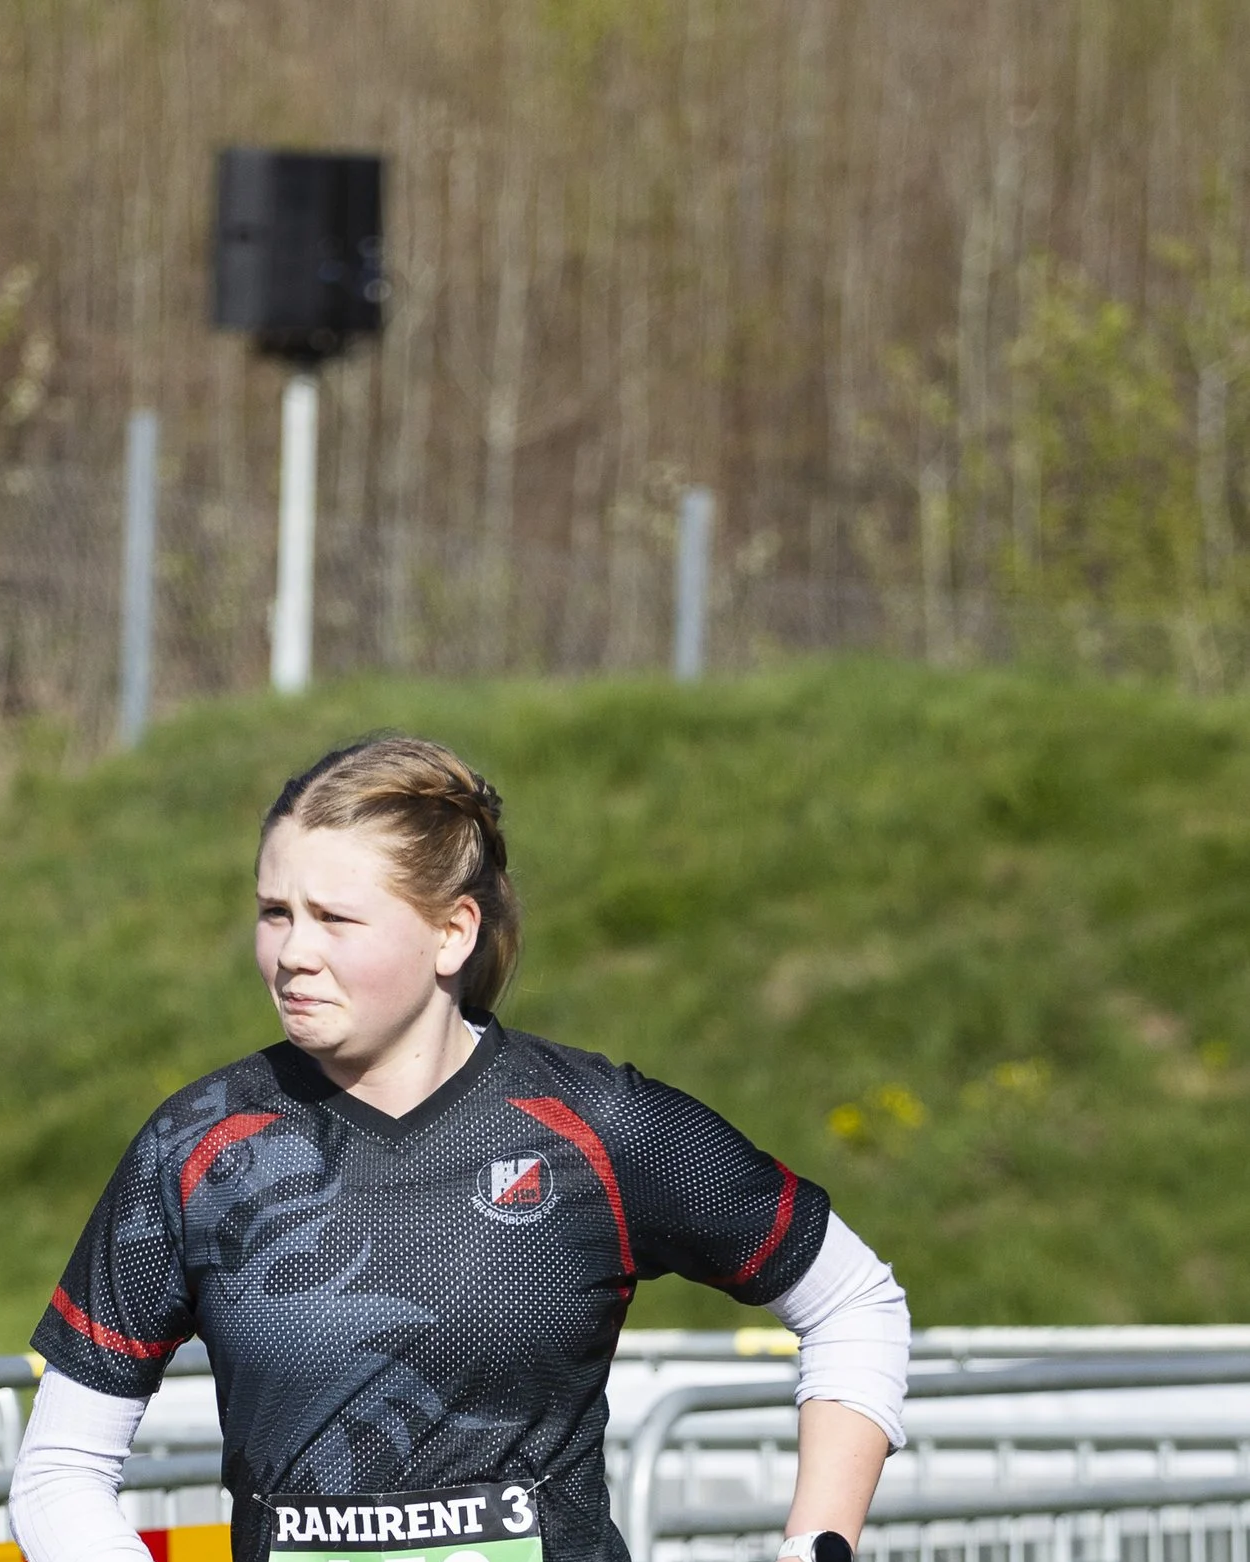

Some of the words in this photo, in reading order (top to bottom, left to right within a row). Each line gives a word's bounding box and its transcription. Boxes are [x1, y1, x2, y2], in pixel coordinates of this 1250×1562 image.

[470, 1194, 543, 1225] HELSINGBORGS
[541, 1194, 561, 1214] SOK
[276, 1497, 486, 1542] RAMIRENT
[501, 1486, 533, 1533] 3
